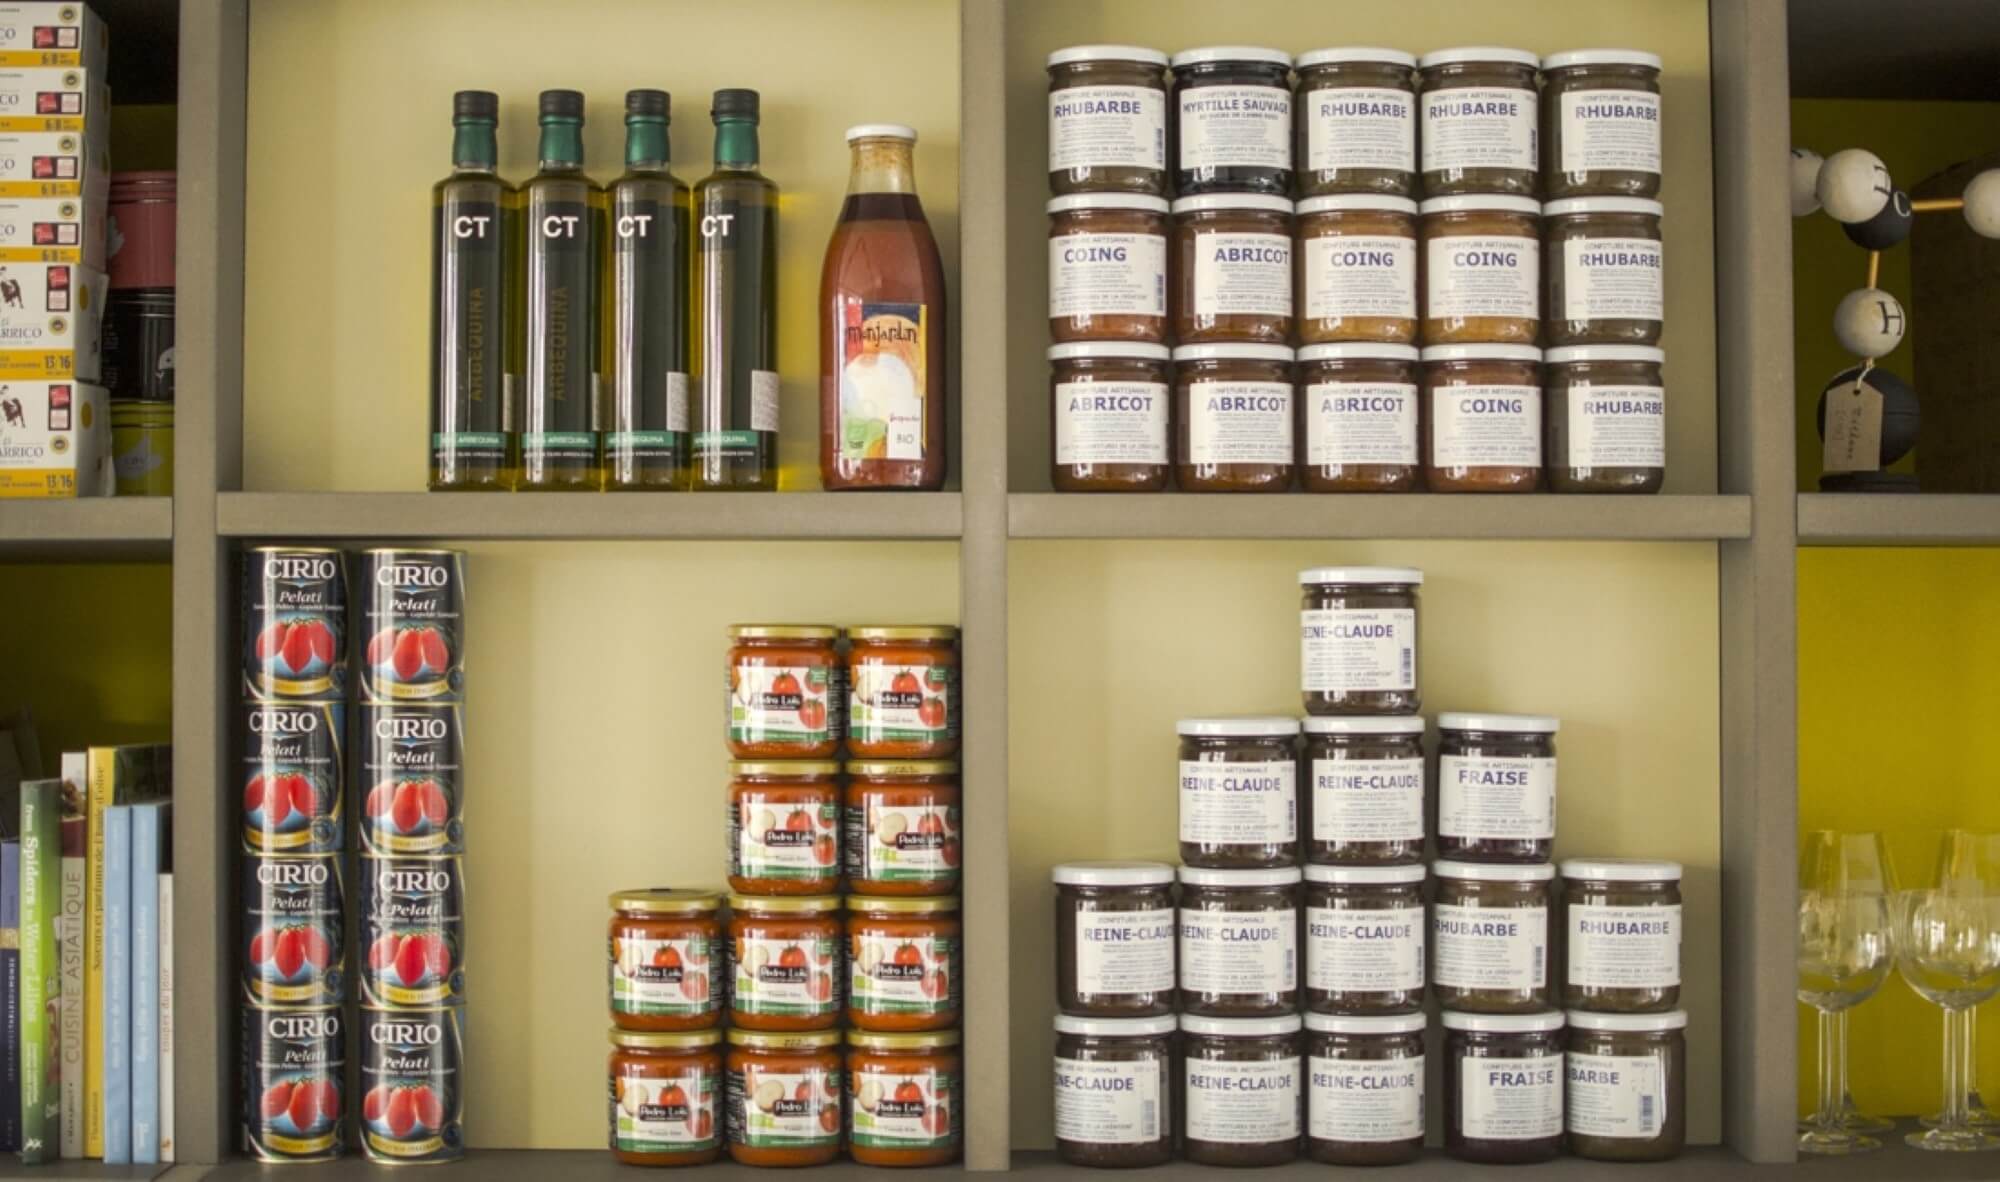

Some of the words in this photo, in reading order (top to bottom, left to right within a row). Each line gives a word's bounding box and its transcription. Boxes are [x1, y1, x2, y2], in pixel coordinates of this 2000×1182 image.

[1054, 100, 1141, 118] RHUBARBE
[1183, 99, 1239, 114] MYRTILLE
[1243, 99, 1288, 114] SAUVAGE
[1320, 102, 1407, 119] RHUBARBE
[1429, 103, 1518, 119] RHUBARBE
[1575, 104, 1657, 121] RHUBARBE
[1893, 190, 1911, 217] C
[454, 216, 490, 238] CT
[543, 216, 579, 238] CT
[617, 216, 652, 237] CT
[701, 215, 734, 237] CT
[1064, 247, 1127, 264] COING
[1214, 248, 1289, 264] ABRICOT
[1331, 252, 1394, 267] COING
[1454, 252, 1517, 267] COING
[1579, 253, 1660, 268] RHUBARBE
[1877, 300, 1903, 336] H
[1070, 396, 1152, 412] ABRICOT
[1207, 396, 1287, 412] ABRICOT
[1321, 397, 1404, 413] ABRICOT
[1460, 399, 1522, 414] COING
[1584, 401, 1663, 415] RHUBARBE
[265, 558, 336, 579] CIRIO
[377, 566, 448, 586] CIRIO
[279, 591, 322, 603] Pelati
[389, 599, 437, 611] Pelati
[250, 711, 317, 732] CIRIO
[376, 718, 447, 739] CIRIO
[387, 751, 435, 764] Pelati
[1182, 776, 1280, 791] REINE-CLAUDE
[1319, 775, 1418, 789] REINE-CLAUDE
[1458, 769, 1528, 785] FRAISE
[257, 864, 328, 884] CIRIO
[380, 871, 450, 892] CIRIO
[271, 897, 314, 909] Pelati
[391, 904, 440, 916] Pelati
[65, 872, 82, 977] ASIATIQUE
[1310, 923, 1411, 939] REINE-CLAUDE
[1580, 920, 1669, 935] RHUBARBE
[64, 987, 81, 1064] CUISINE
[269, 1016, 338, 1038] CIRIO
[371, 1023, 442, 1044] CIRIO
[382, 1056, 430, 1069] Pelati
[1190, 1074, 1291, 1091] REINE-CLAUDE
[1313, 1073, 1415, 1090] REINE-CLAUDE
[1489, 1069, 1553, 1087] FRAISE
